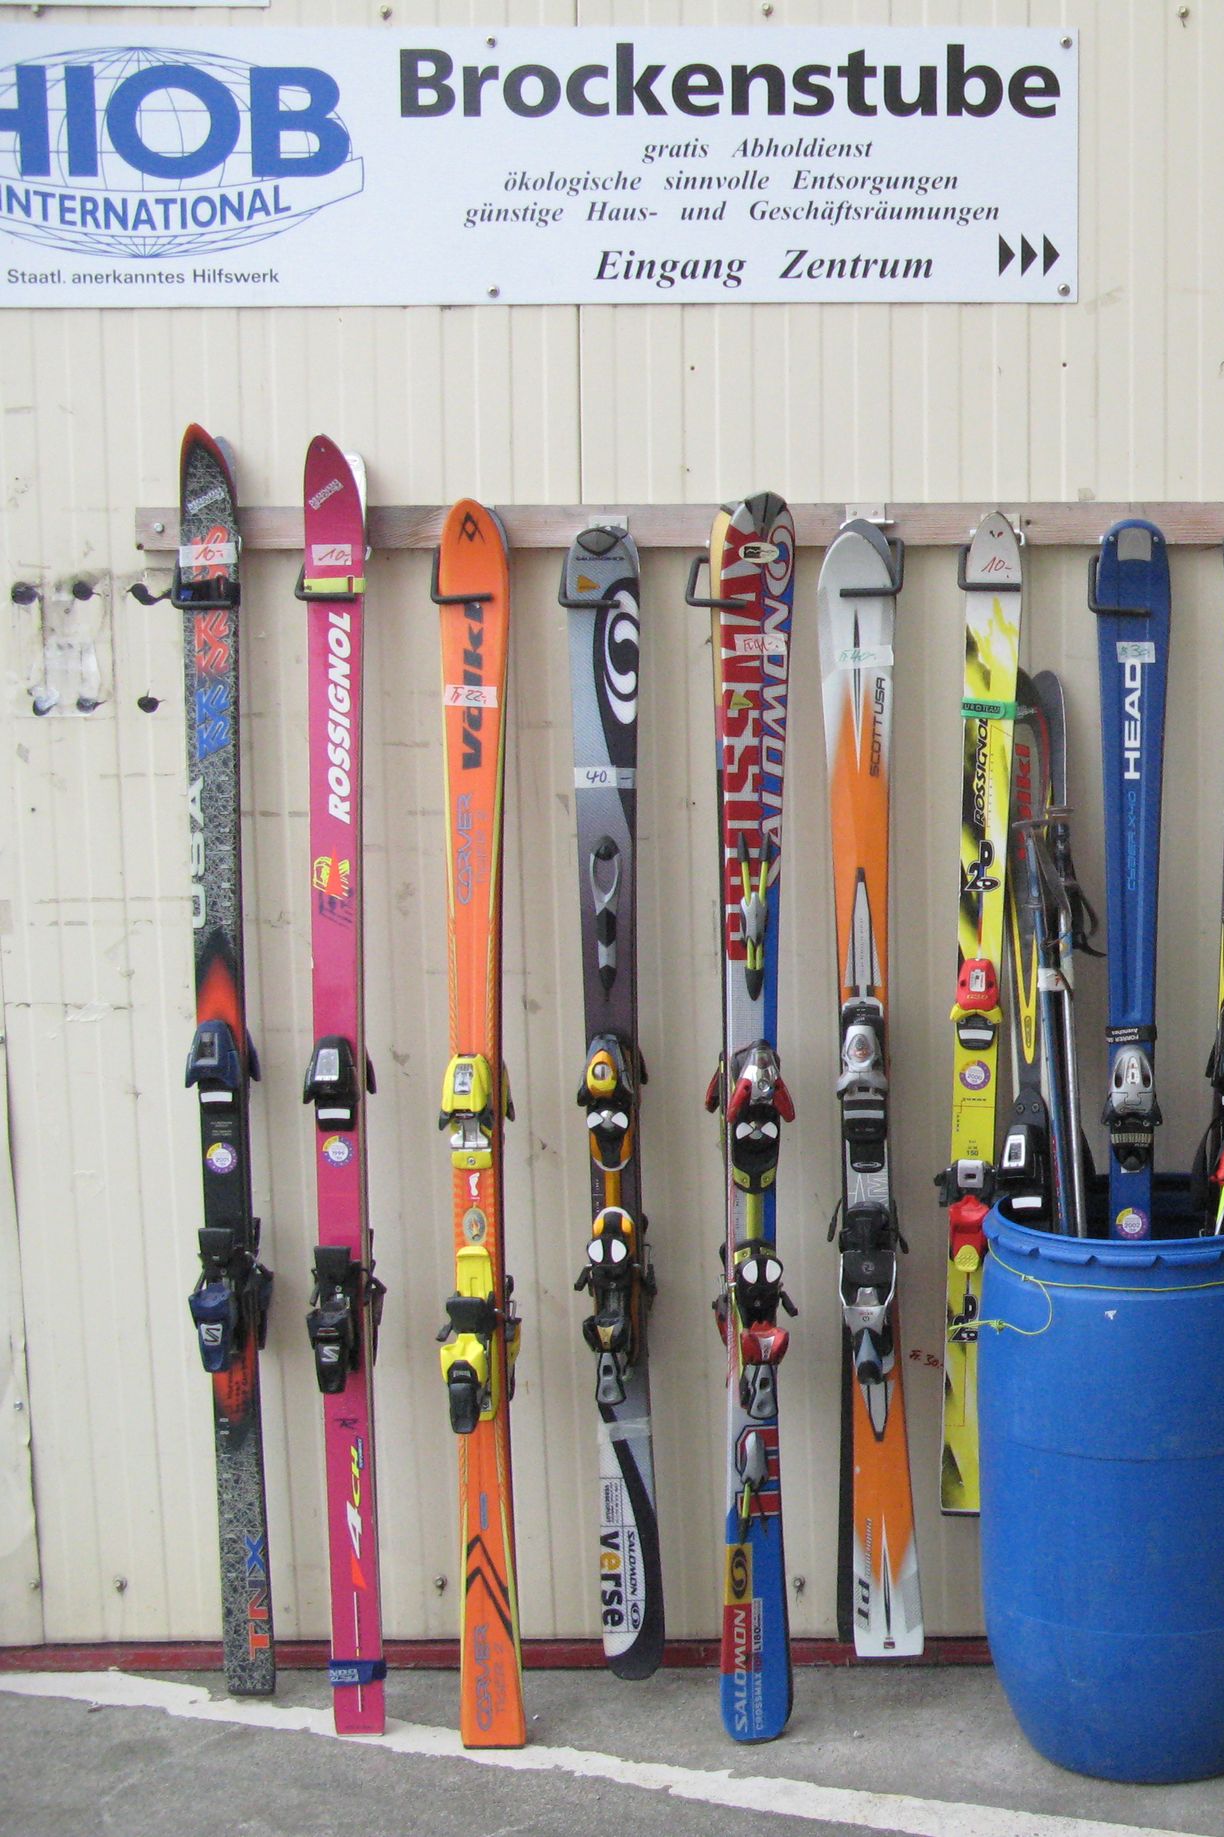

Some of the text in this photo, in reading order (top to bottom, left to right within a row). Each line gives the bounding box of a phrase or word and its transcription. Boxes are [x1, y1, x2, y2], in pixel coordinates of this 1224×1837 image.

[400, 43, 1061, 118] Brockenstube
[504, 171, 958, 195] ökologische sinnvolle Entsorgungen
[642, 138, 873, 163] gratis Abholdienst
[464, 200, 1000, 227] günstige Haus- und Geschäftsräumungen
[7, 269, 279, 284] Staatl. anerkanntes Hilfswerk
[596, 250, 934, 288] Eingang Zentrum
[327, 611, 351, 824] ROSSIGNOL
[869, 677, 886, 778] SCOTT USA
[1124, 658, 1142, 780] HEAD
[188, 775, 207, 928] USA
[600, 1530, 625, 1628] verse
[627, 1528, 638, 1597] SALOMON
[734, 1609, 748, 1733] SALOMON
